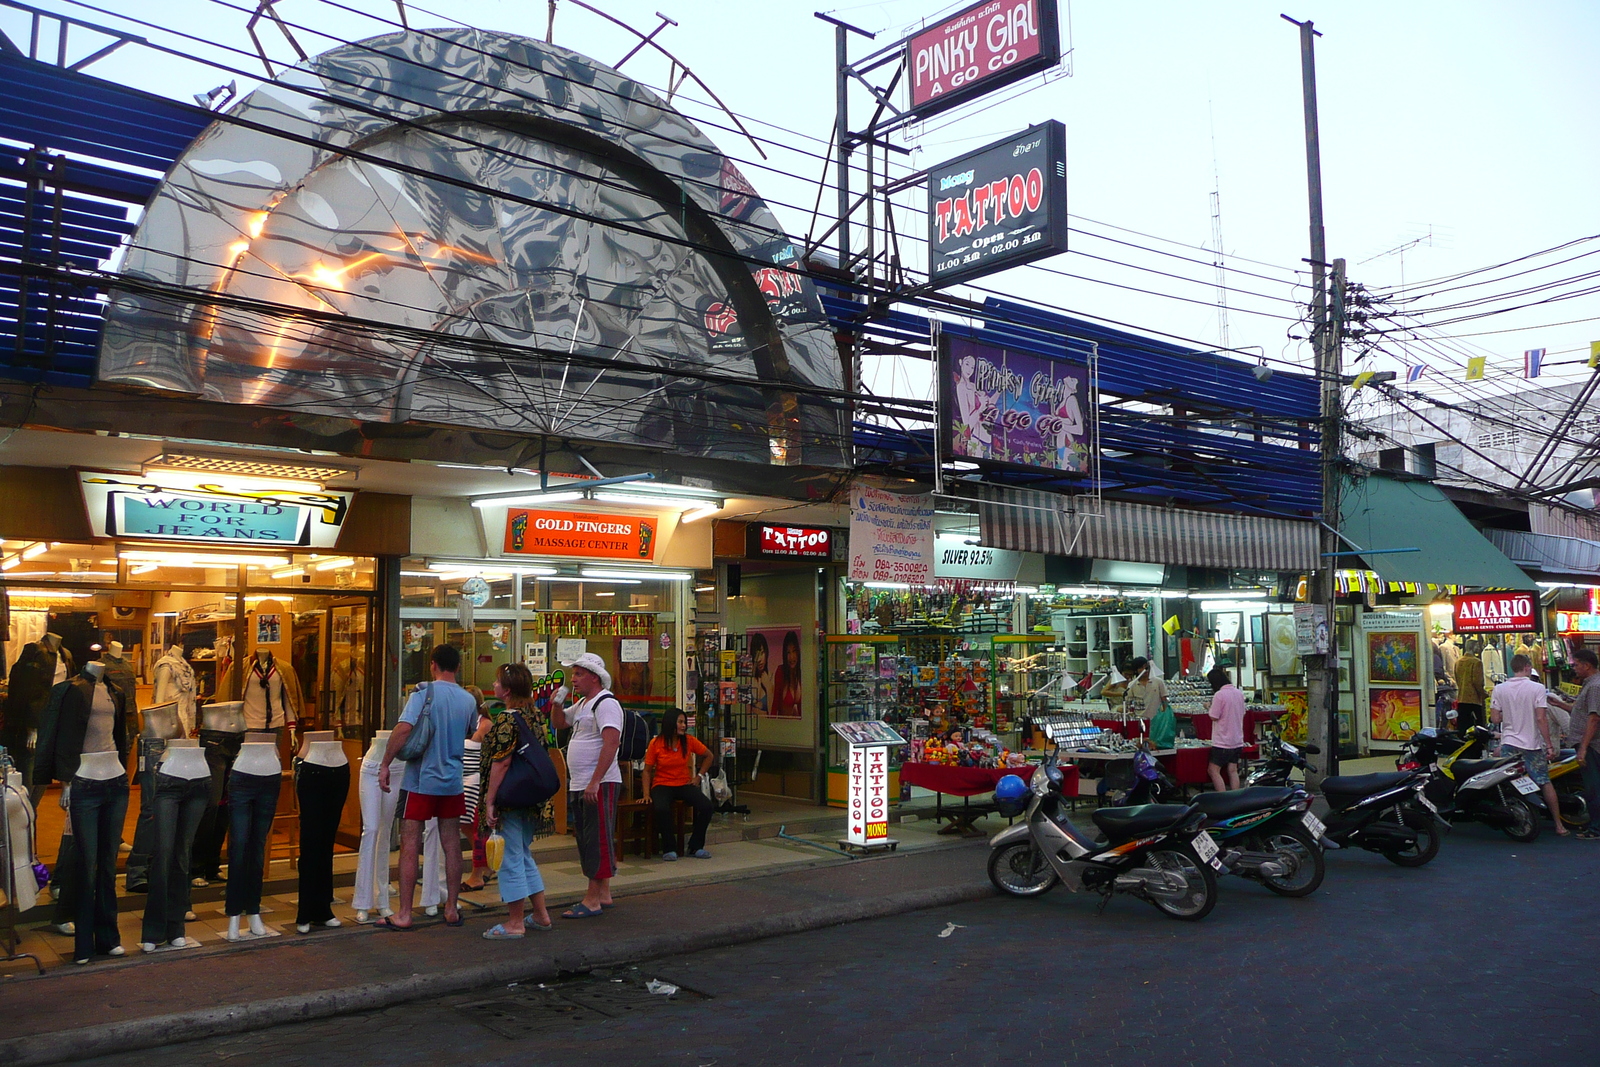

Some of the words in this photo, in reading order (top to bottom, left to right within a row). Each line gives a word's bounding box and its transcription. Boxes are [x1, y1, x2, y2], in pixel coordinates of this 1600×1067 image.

[916, 25, 978, 87] PINKY
[986, 0, 1038, 52] GIRL
[930, 82, 943, 97] A
[951, 66, 979, 86] GO
[988, 49, 1018, 71] CO
[935, 168, 1044, 244] TATTOO
[972, 232, 1004, 249] Open
[992, 239, 1018, 254] 02.00
[144, 498, 284, 516] WORLD
[179, 514, 244, 526] FOR
[536, 518, 574, 531] GOLD
[576, 521, 632, 535] FINGERS
[145, 524, 280, 540] JEANS
[763, 526, 828, 549] TATTOO
[534, 538, 586, 548] MASSAGE
[588, 540, 628, 550] CENTER
[942, 550, 968, 565] SILVER
[970, 550, 993, 565] 92.5%
[1459, 598, 1530, 618] AMARIO
[544, 614, 586, 626] HAPPY
[590, 614, 618, 628] NEW
[622, 614, 654, 628] YEAR
[852, 752, 862, 820] TATTOO
[870, 752, 884, 818] TATTOO
[866, 823, 887, 837] MONG
